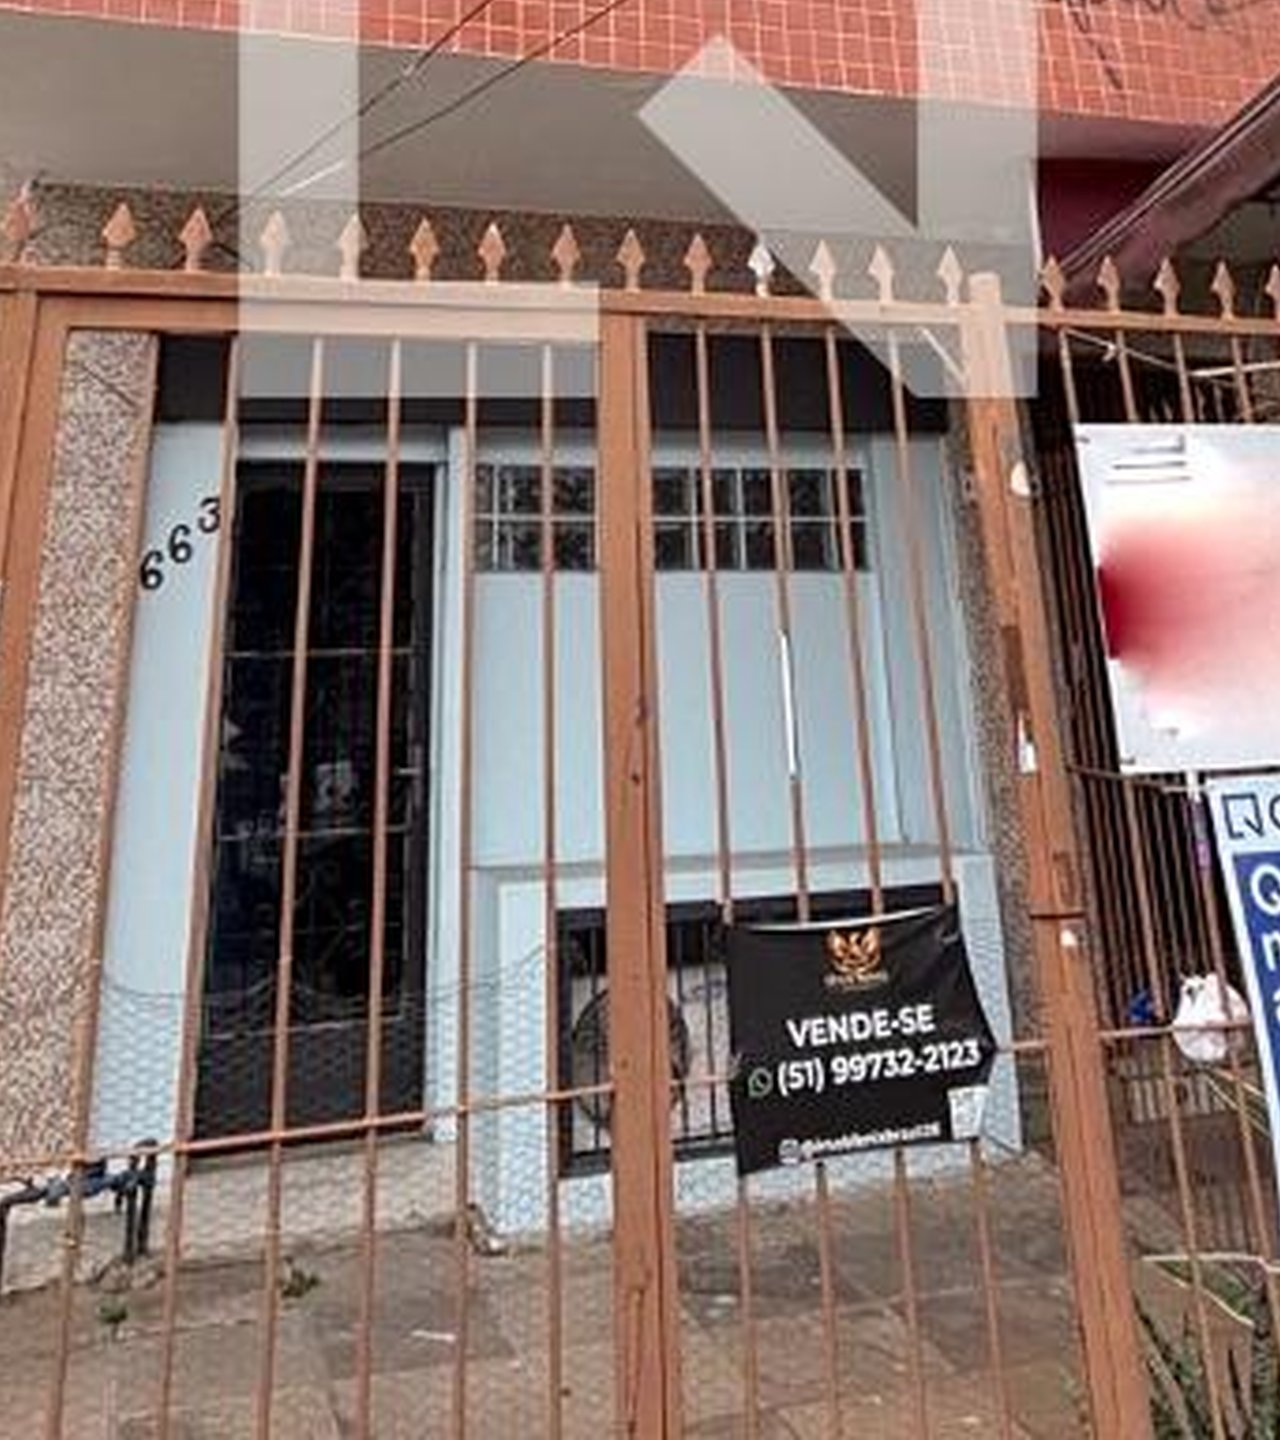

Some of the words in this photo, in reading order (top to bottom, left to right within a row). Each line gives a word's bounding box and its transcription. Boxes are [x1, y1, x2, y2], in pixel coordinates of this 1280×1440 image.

[140, 496, 220, 590] 663
[786, 1004, 936, 1049] VENDE-SE
[777, 1058, 825, 1097] (51)
[830, 1039, 982, 1086] 99732-2123
